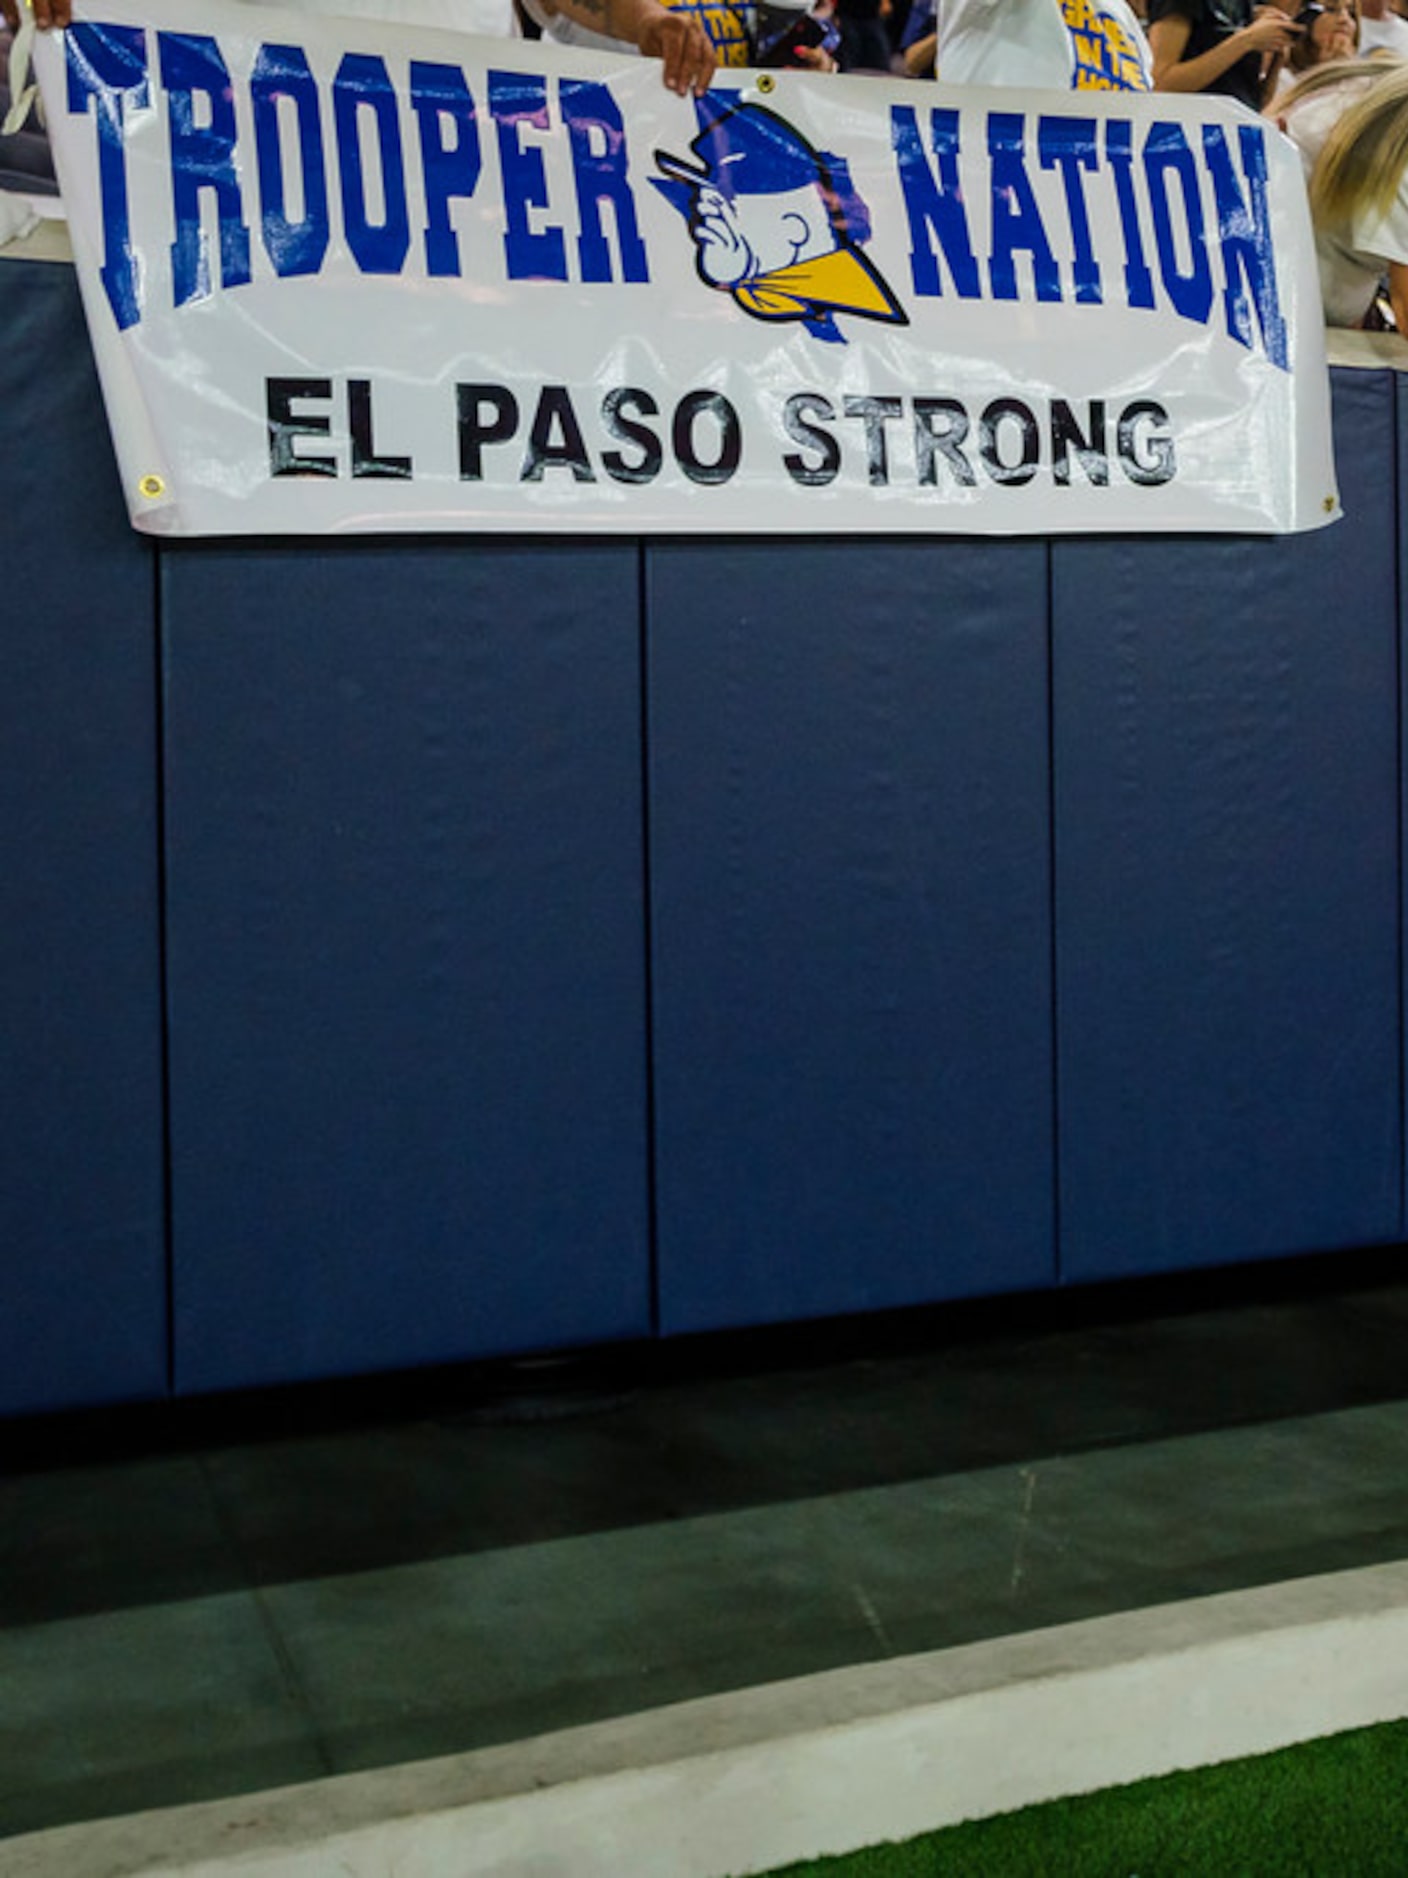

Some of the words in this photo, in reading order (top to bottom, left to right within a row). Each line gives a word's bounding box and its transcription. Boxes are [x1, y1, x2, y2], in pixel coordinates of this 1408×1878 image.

[65, 21, 651, 332] TROOPER
[890, 104, 1291, 373] NATION
[265, 376, 412, 480] EL
[456, 382, 742, 485] PASO
[782, 392, 1177, 487] STRONG
